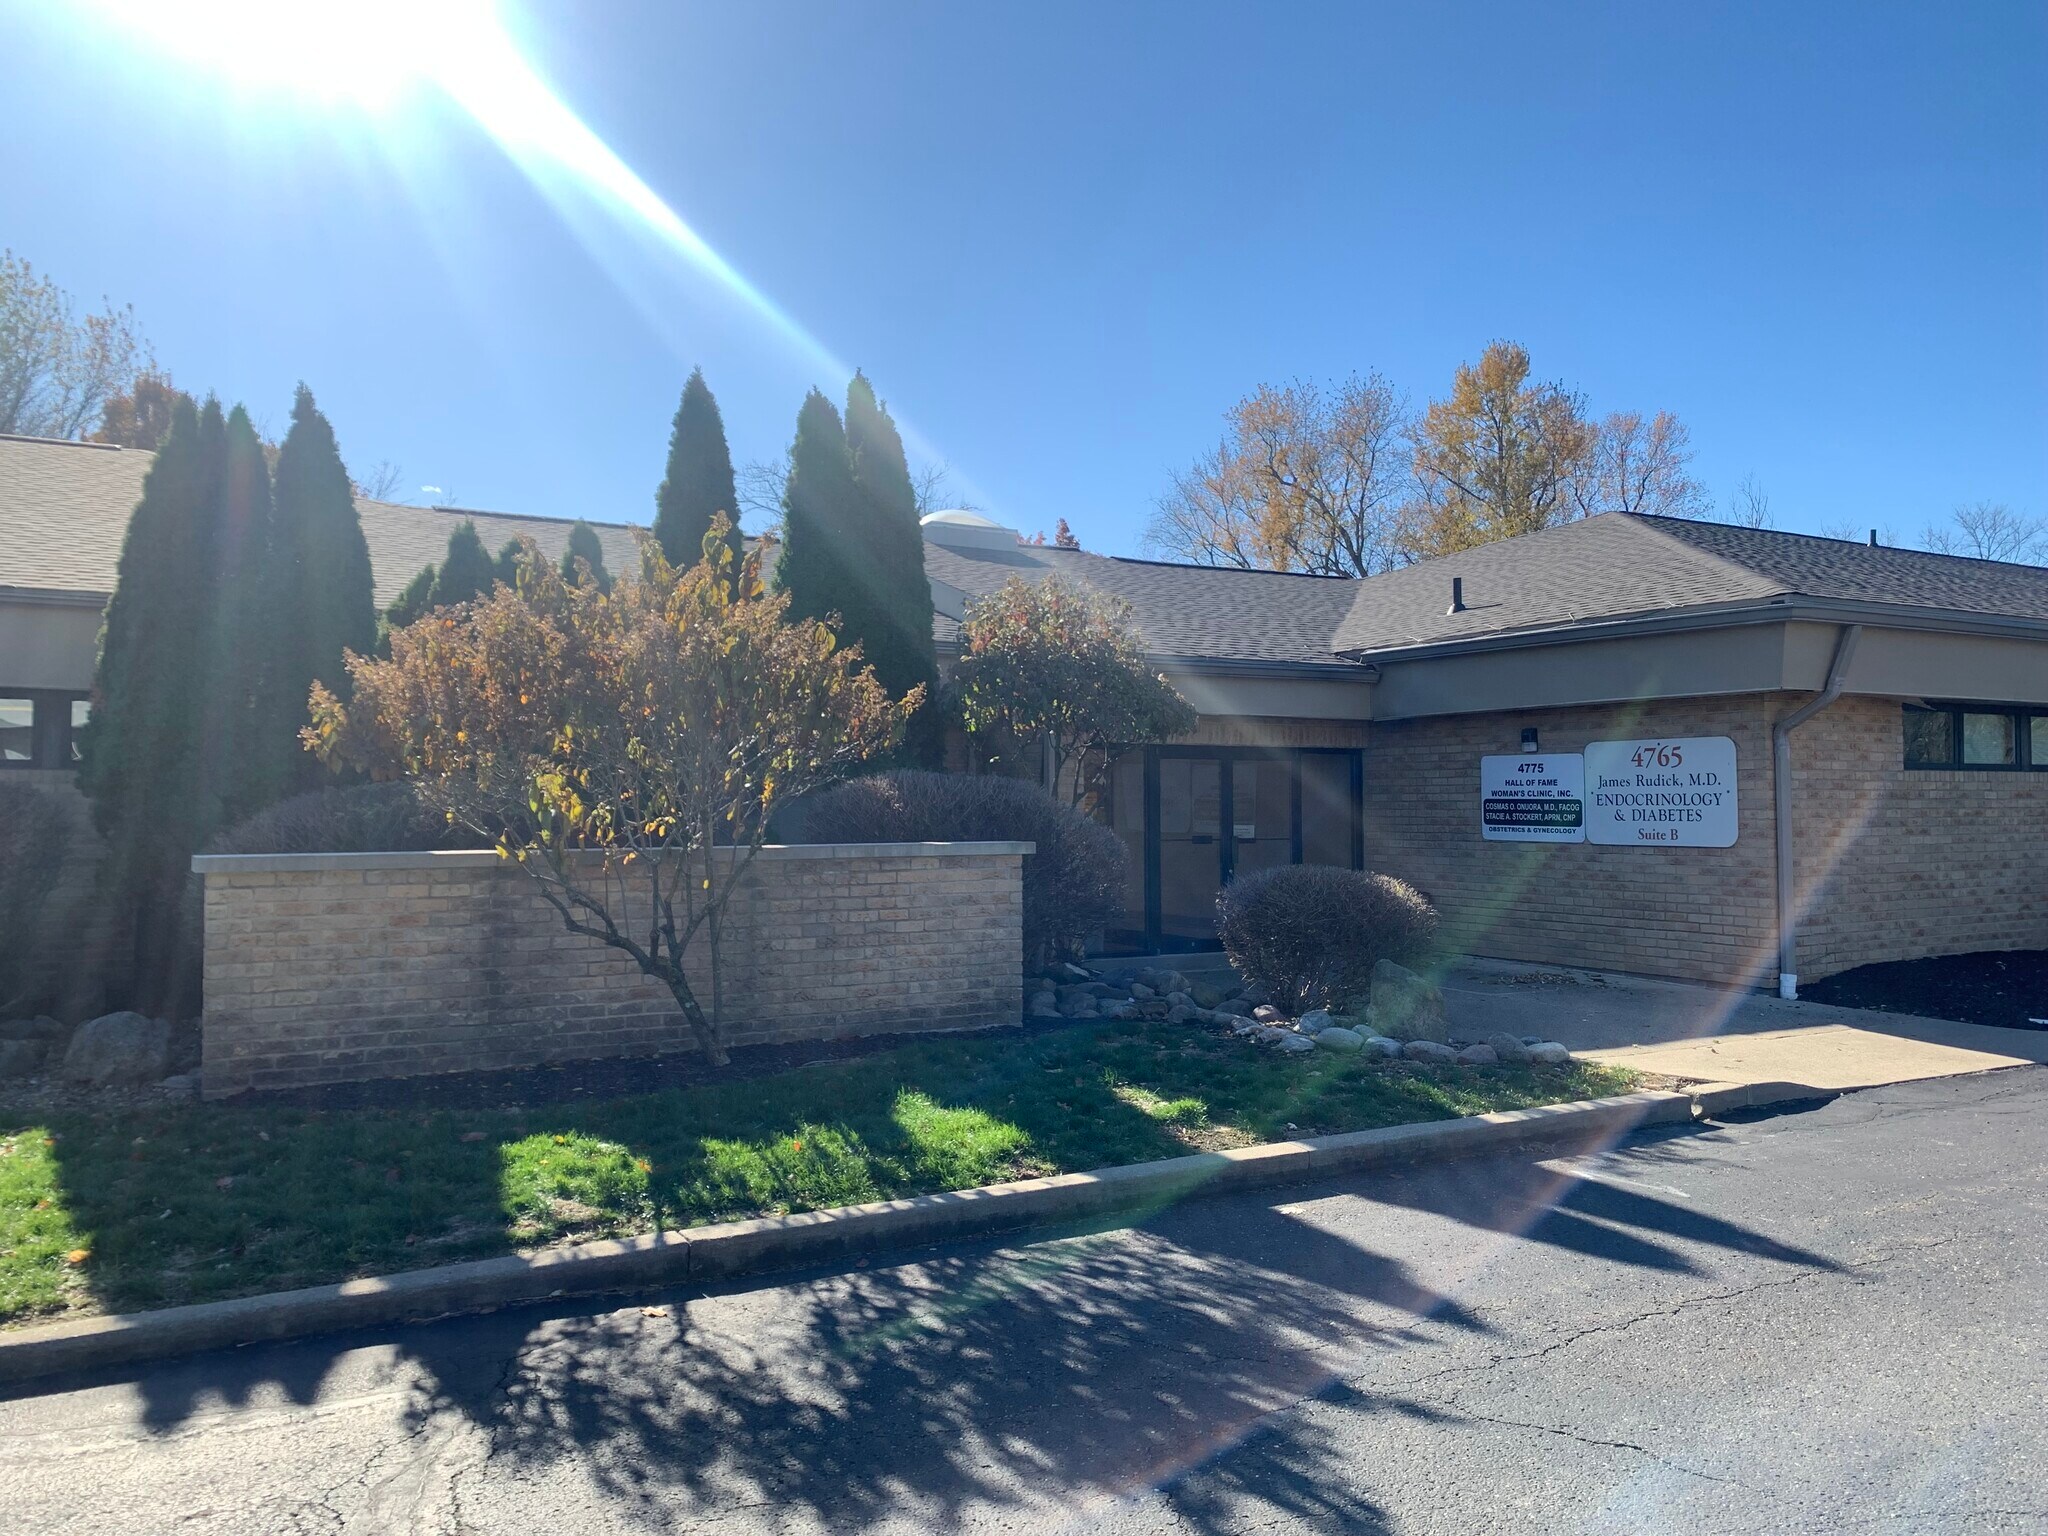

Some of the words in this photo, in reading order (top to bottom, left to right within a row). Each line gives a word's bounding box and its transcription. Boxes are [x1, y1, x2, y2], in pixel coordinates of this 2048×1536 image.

[1631, 745, 1683, 768] 4765
[1518, 763, 1544, 773] 4775
[1598, 774, 1631, 789] James
[1636, 773, 1683, 788] Rudick,
[1689, 772, 1721, 786] M.D.
[1527, 790, 1555, 798] CLINIC,
[1596, 793, 1722, 806] ENDOCRINOLOGY
[1614, 809, 1626, 822] &
[1632, 808, 1703, 822] DIABETES
[1637, 828, 1667, 840] Suite
[1670, 828, 1679, 840] B
